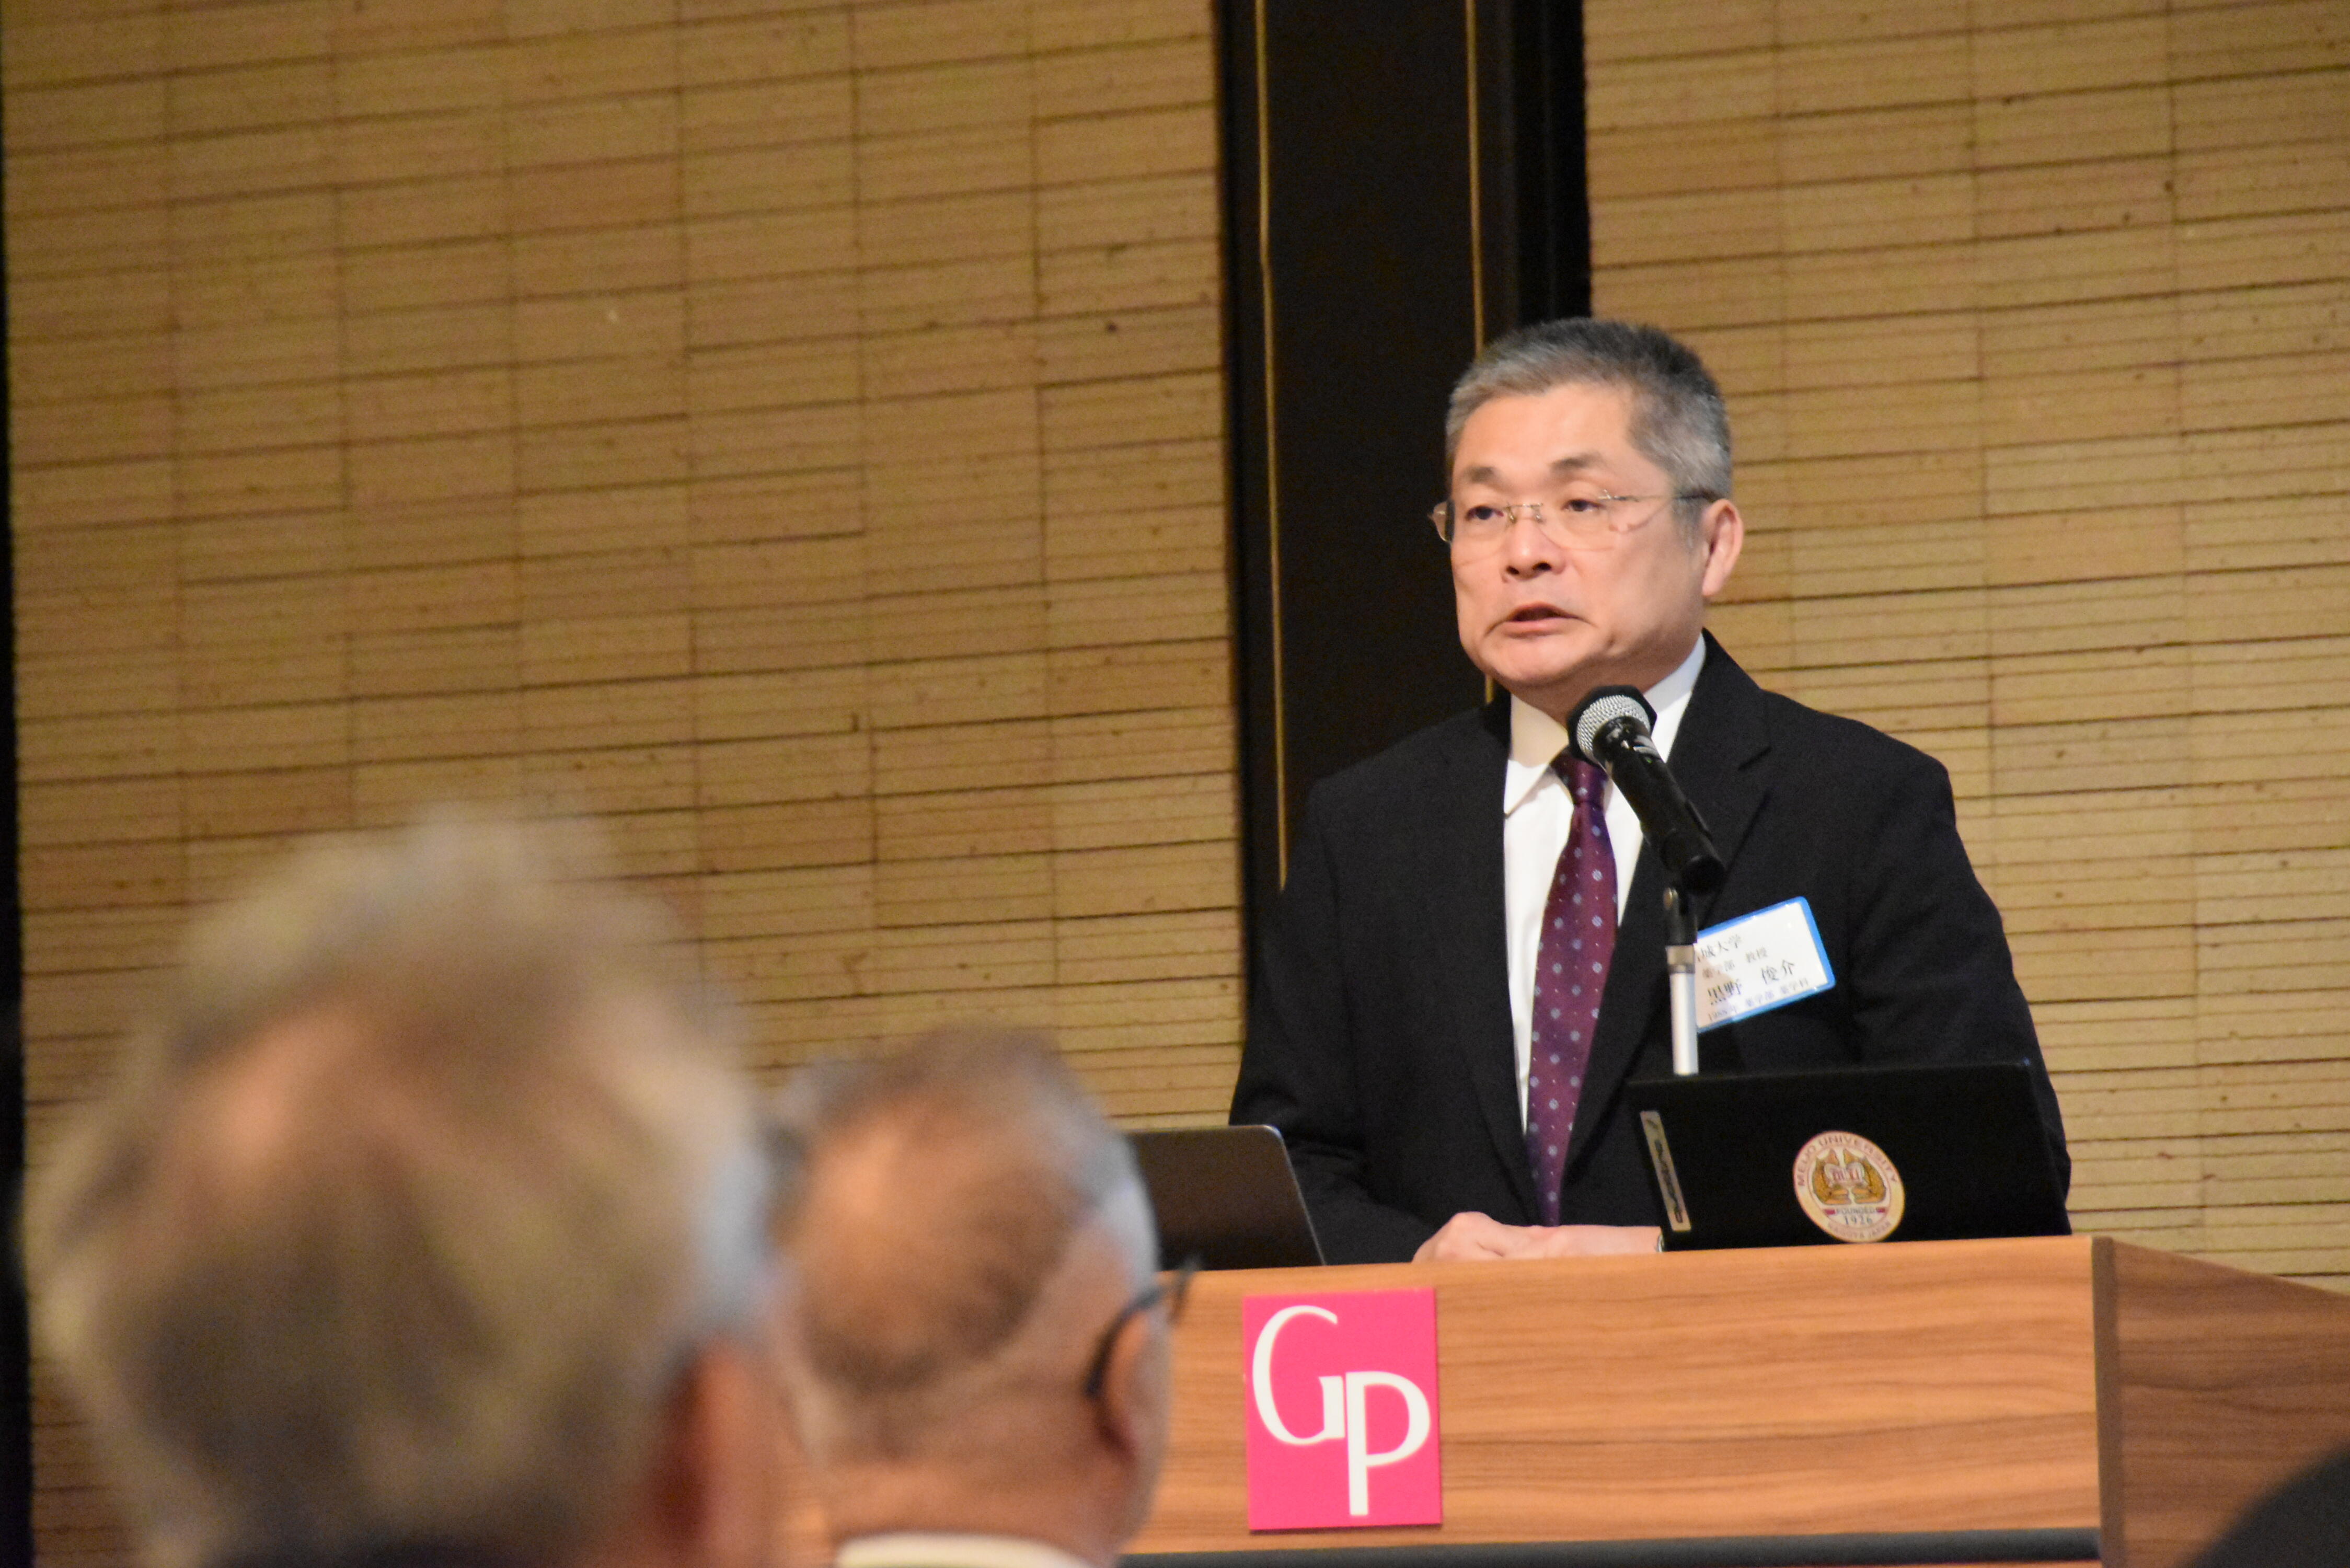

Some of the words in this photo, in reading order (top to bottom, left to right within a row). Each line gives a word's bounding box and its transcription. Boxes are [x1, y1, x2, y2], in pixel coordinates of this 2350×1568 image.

[1697, 935, 1741, 963] 城大学
[1707, 979, 1743, 1006] 黒野
[1761, 959, 1794, 985] 俊介
[1797, 1145, 1816, 1186] MEIJO
[1818, 1135, 1896, 1181] UNIVERSITY
[1836, 1206, 1874, 1214] FOUNDED
[1842, 1215, 1872, 1224] 1926
[1252, 1305, 1431, 1516] GP
